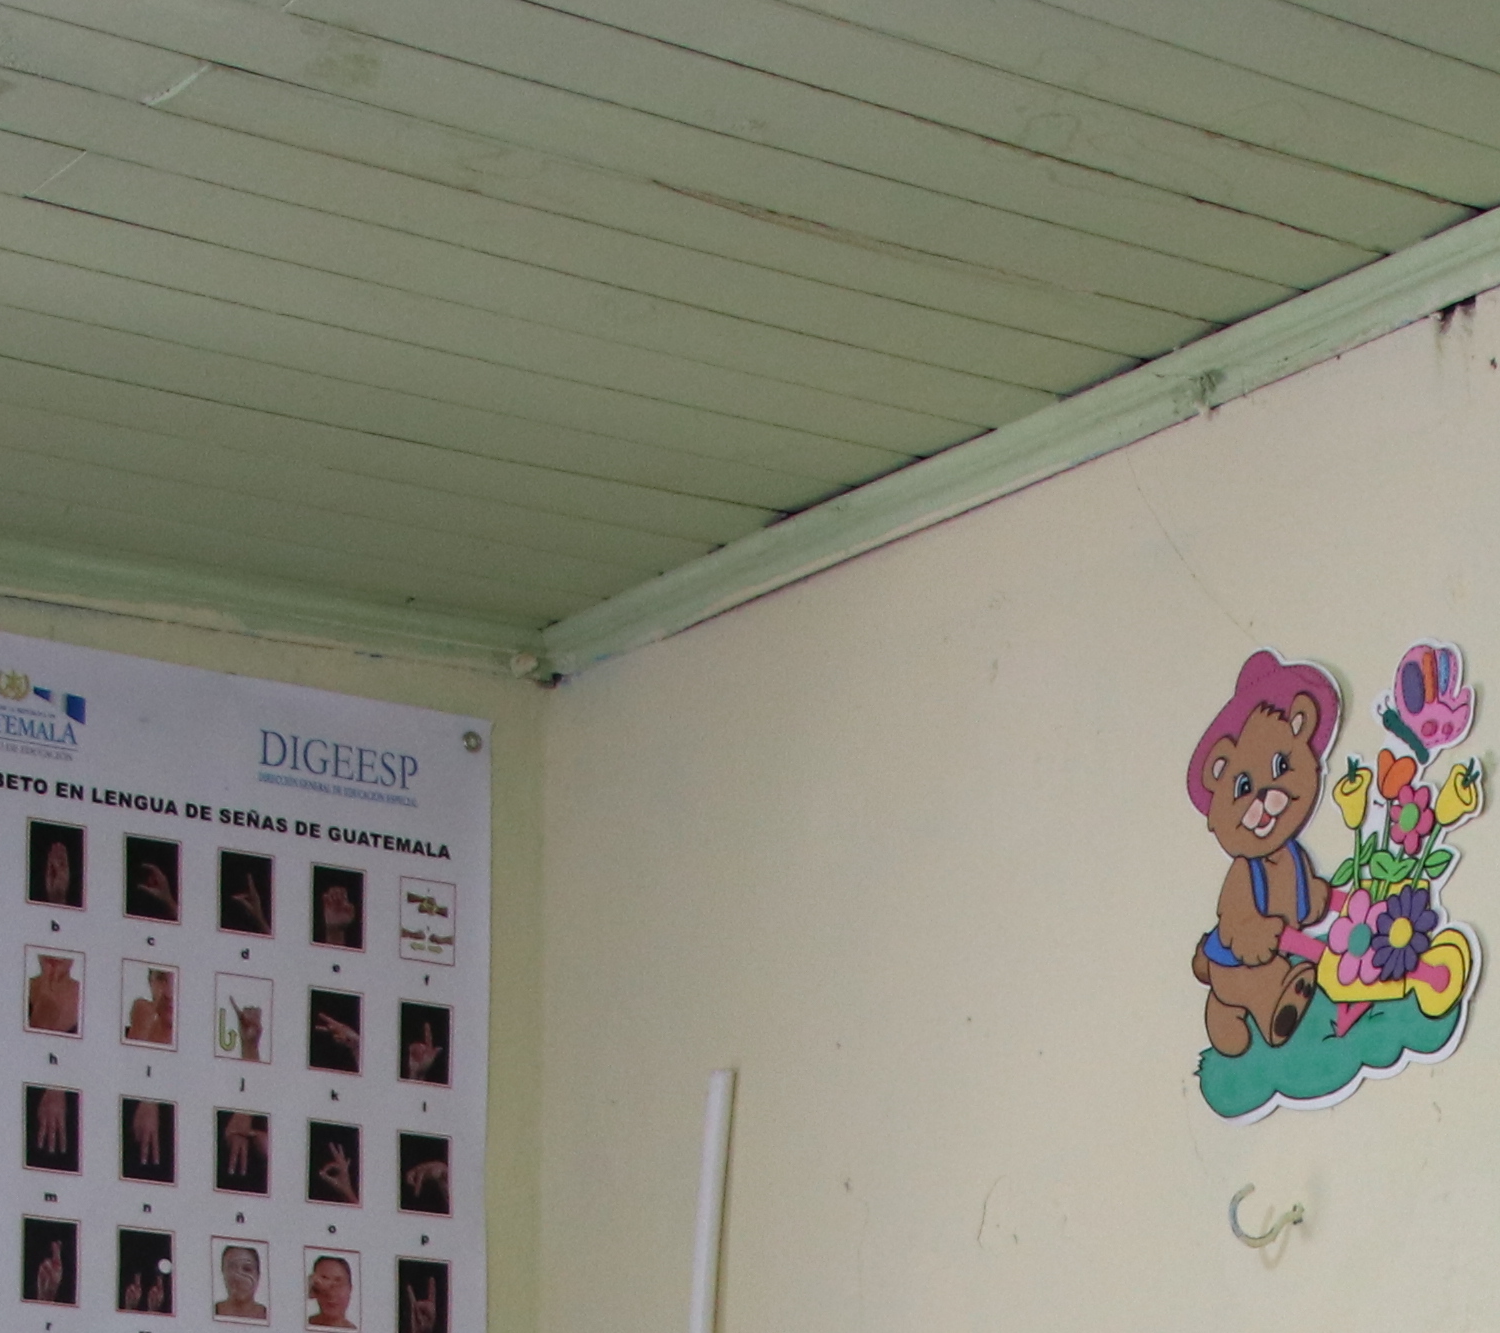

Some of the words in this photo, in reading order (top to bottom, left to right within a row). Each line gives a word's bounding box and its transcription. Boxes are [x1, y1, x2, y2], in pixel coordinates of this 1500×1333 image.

[259, 728, 419, 790] DIGEESP
[56, 782, 83, 800] EN
[92, 788, 178, 815] LENGUA
[186, 803, 211, 821] DE
[220, 809, 287, 833] SEÑAS
[295, 821, 320, 838] DE
[328, 826, 450, 859] GUATEMALA
[51, 921, 60, 932] b
[147, 937, 154, 946] c
[241, 949, 249, 959] d
[424, 975, 429, 985] f
[49, 1053, 57, 1064] h
[331, 1090, 338, 1100] k
[44, 1193, 57, 1202] m
[143, 1204, 151, 1212] n
[236, 1213, 244, 1223] ñ
[328, 1225, 336, 1234] o
[421, 1235, 429, 1245] p
[46, 1322, 52, 1331] r
